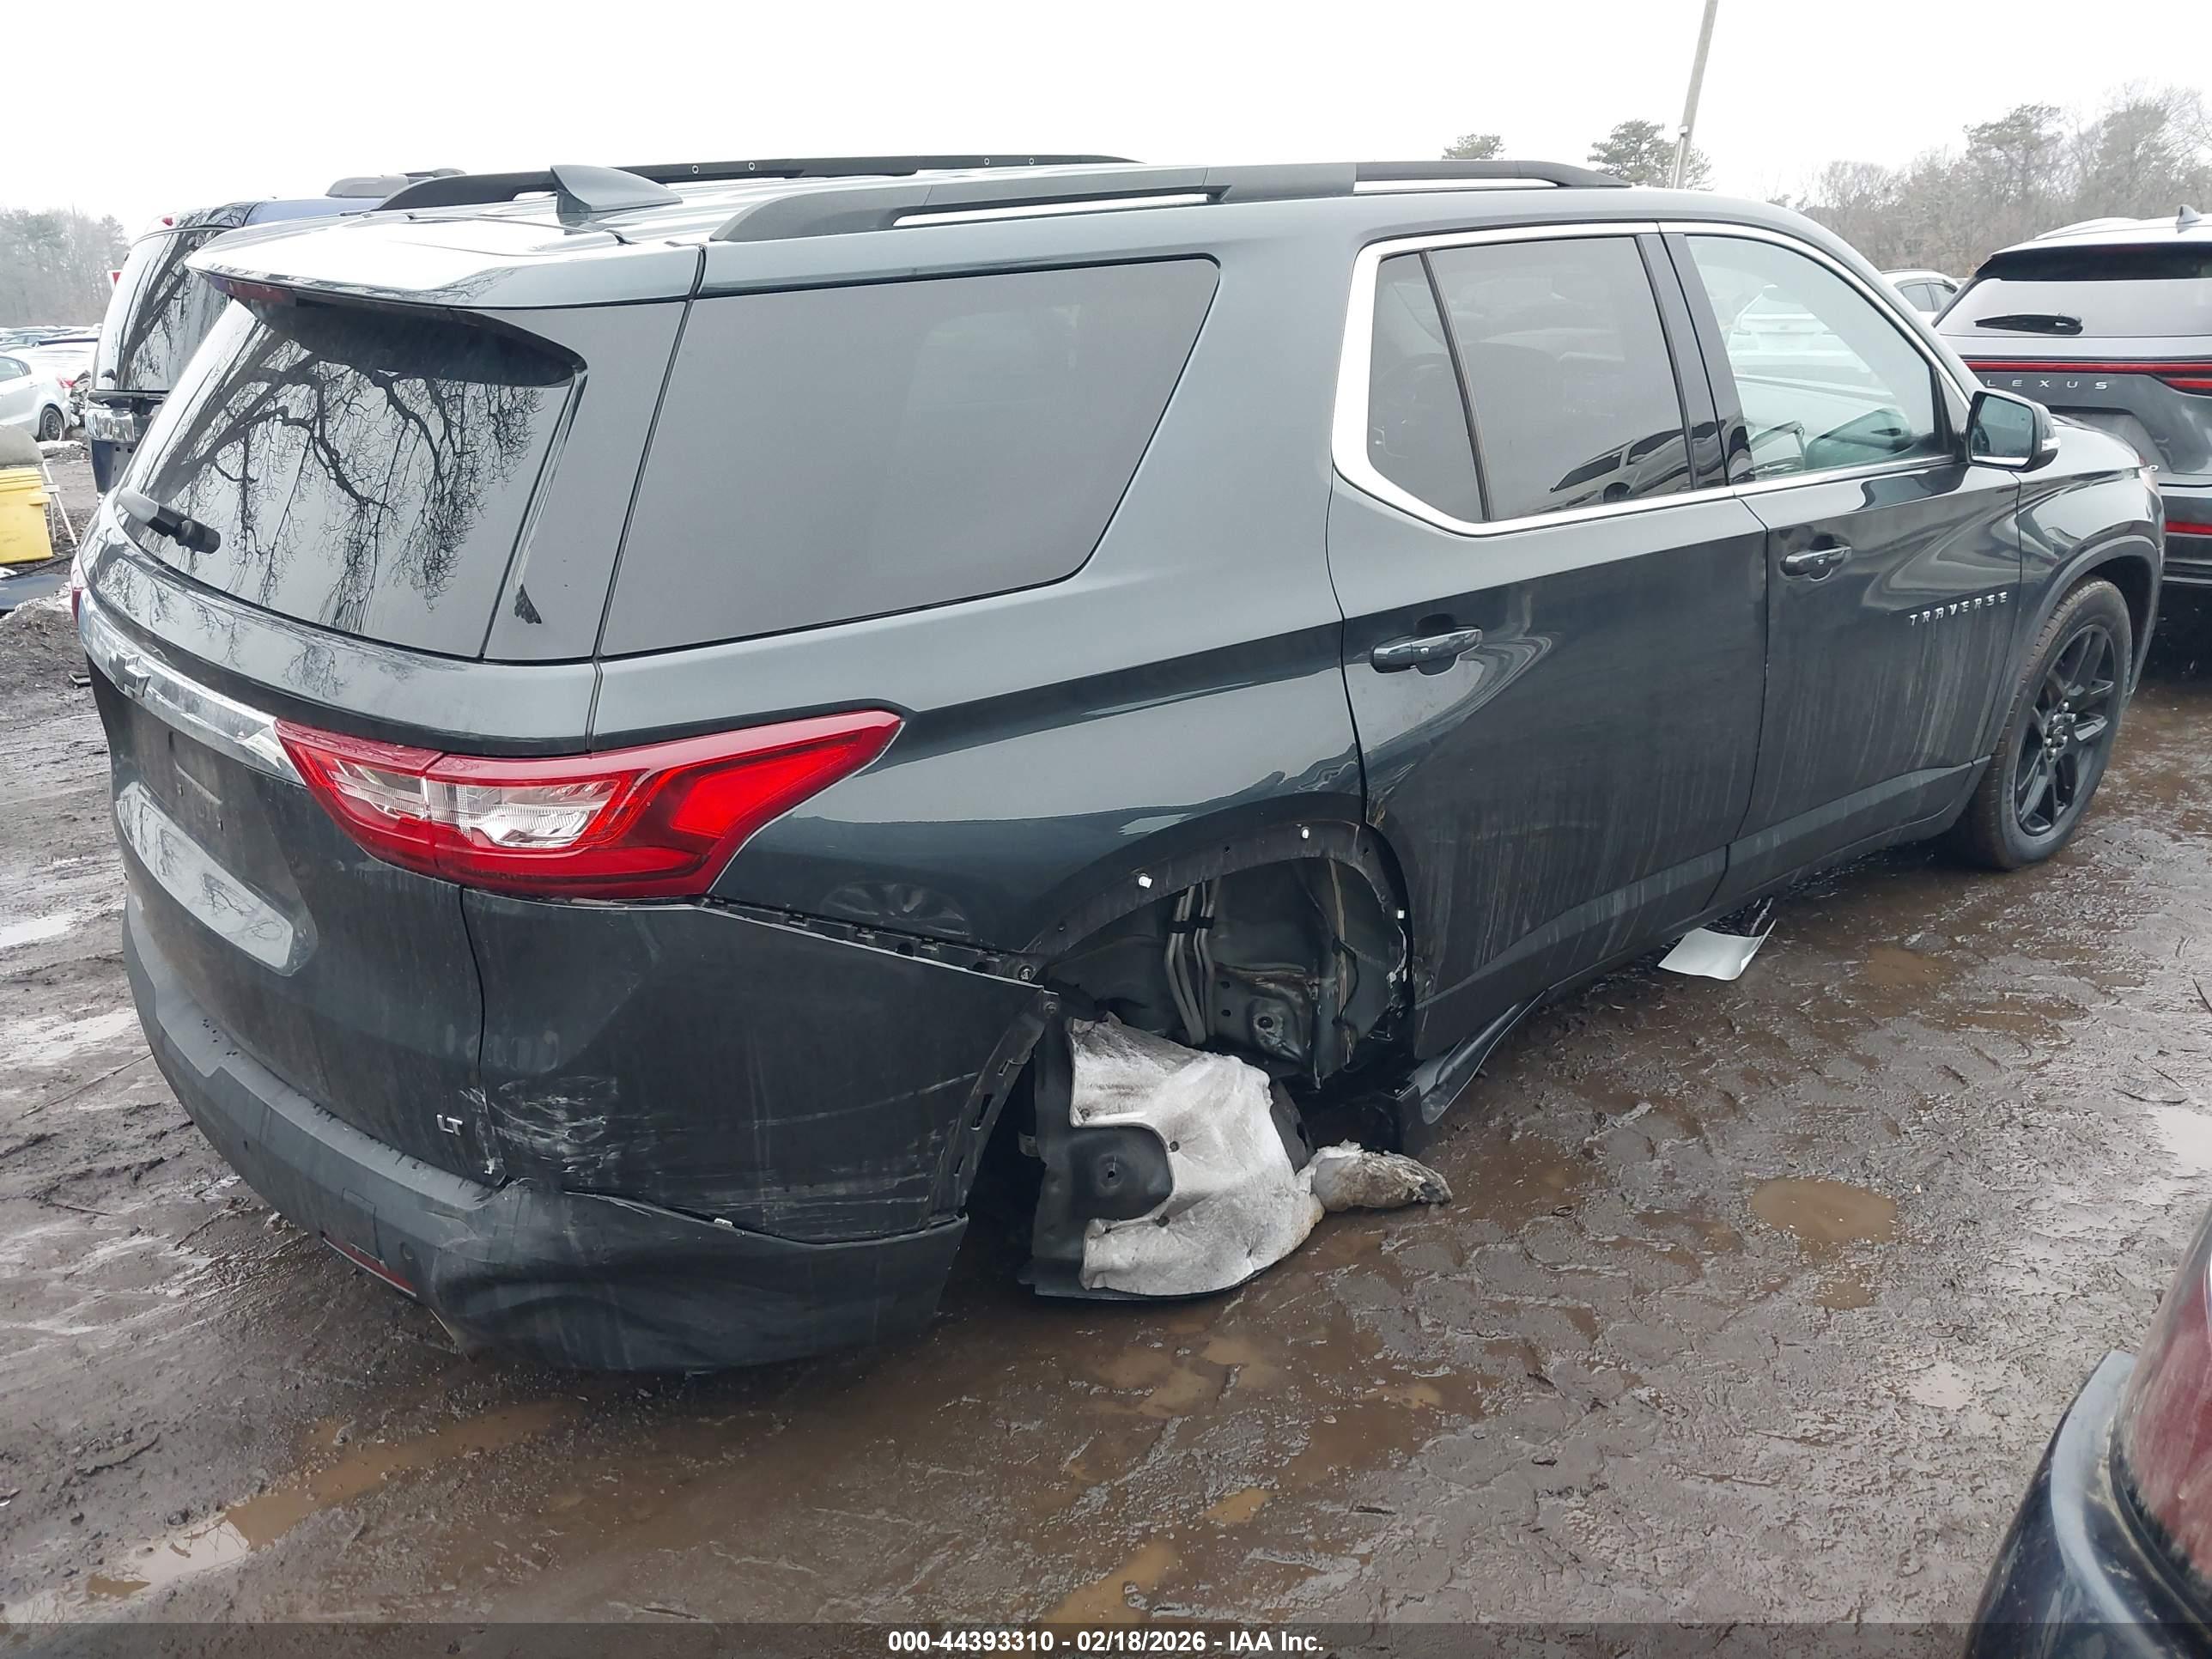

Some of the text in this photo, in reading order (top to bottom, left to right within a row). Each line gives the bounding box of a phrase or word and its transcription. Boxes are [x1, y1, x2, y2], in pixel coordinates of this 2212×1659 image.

[1986, 379, 2109, 390] LEXUS
[1909, 591, 2008, 626] TRAVERSE
[436, 1114, 464, 1137] LT
